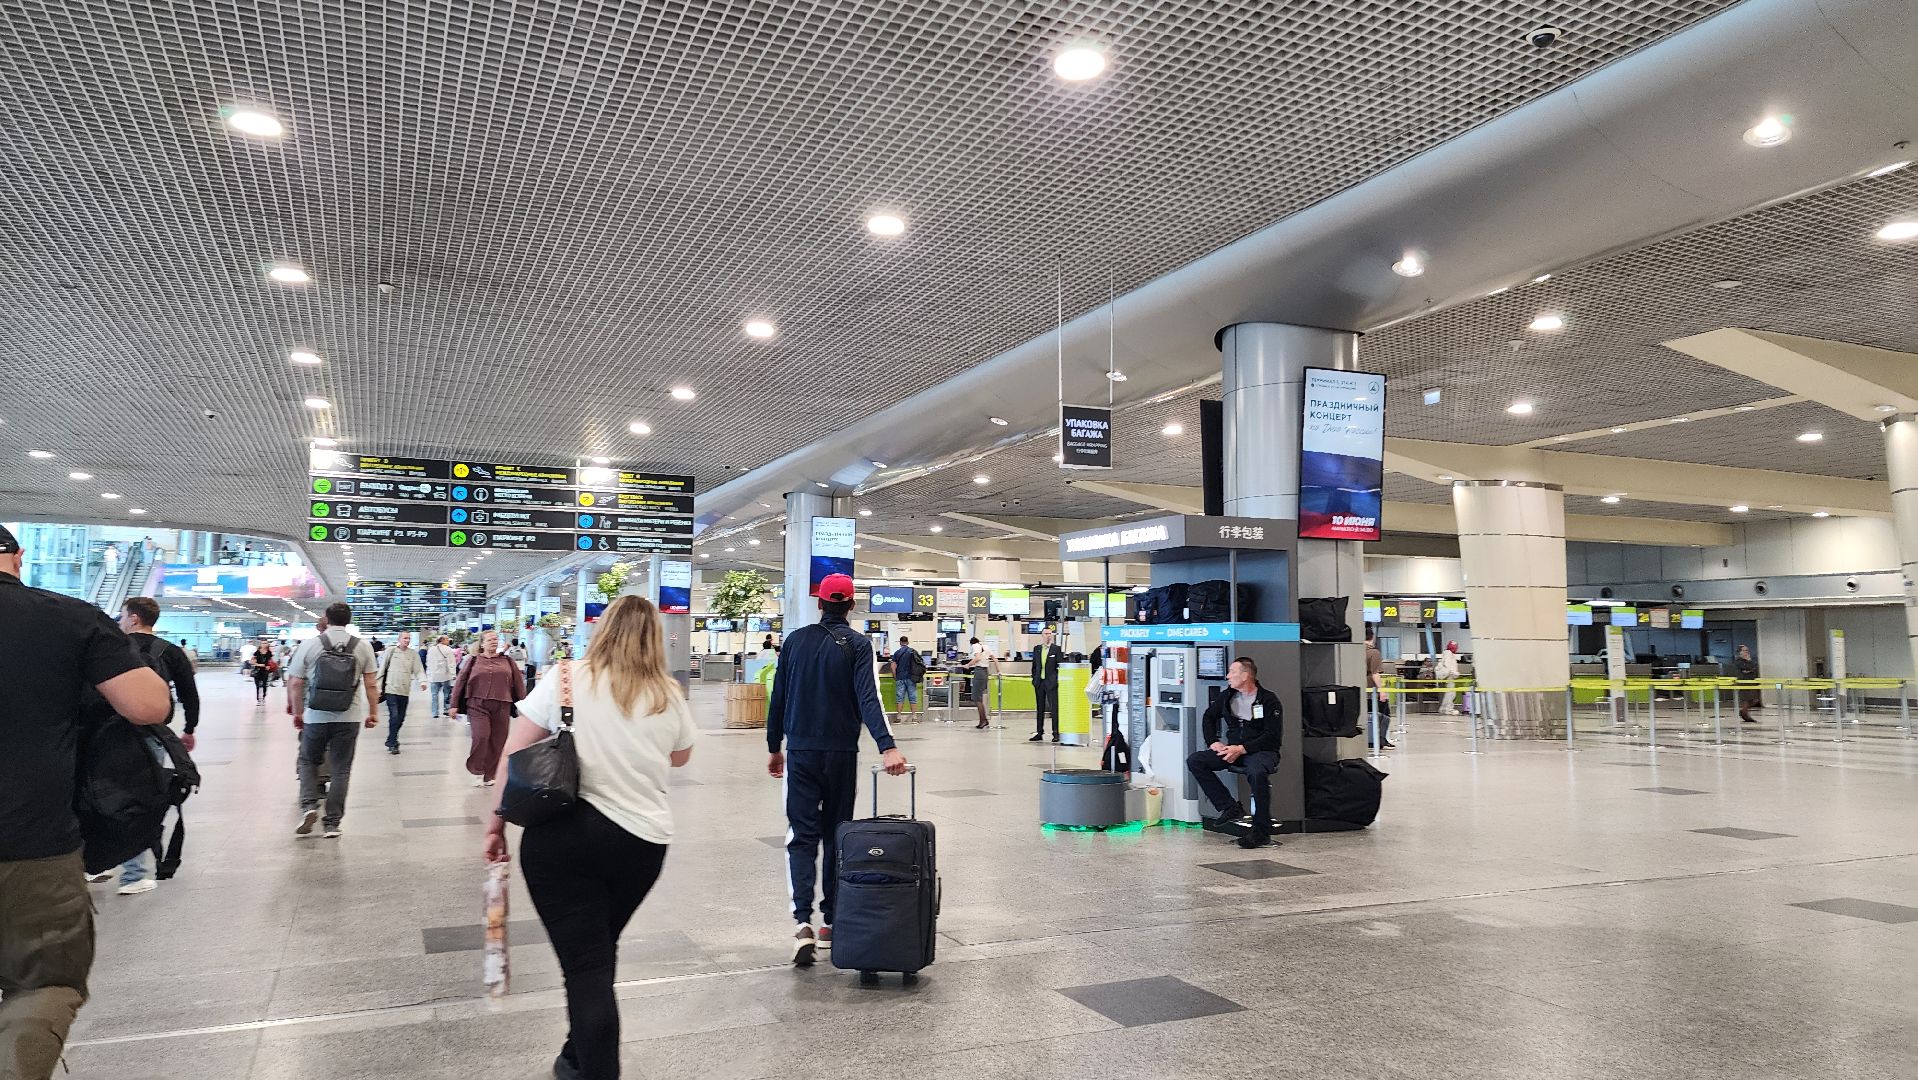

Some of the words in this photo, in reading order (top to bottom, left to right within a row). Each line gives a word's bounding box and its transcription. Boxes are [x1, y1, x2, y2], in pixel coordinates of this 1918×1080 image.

[1310, 399, 1379, 412] ПРАЗДНИЧНЫЙ
[1309, 412, 1352, 421] КОНЦЕРТ
[1065, 418, 1109, 430] УПАКОВКА
[1070, 429, 1104, 439] БАГАЖА
[387, 483, 394, 491] 2
[357, 506, 399, 514] АВТОБУСЫ
[1332, 516, 1344, 526] 10
[1218, 525, 1265, 541] 行李包装
[918, 594, 934, 607] 33
[972, 596, 987, 608] 32
[1071, 599, 1086, 611] 31
